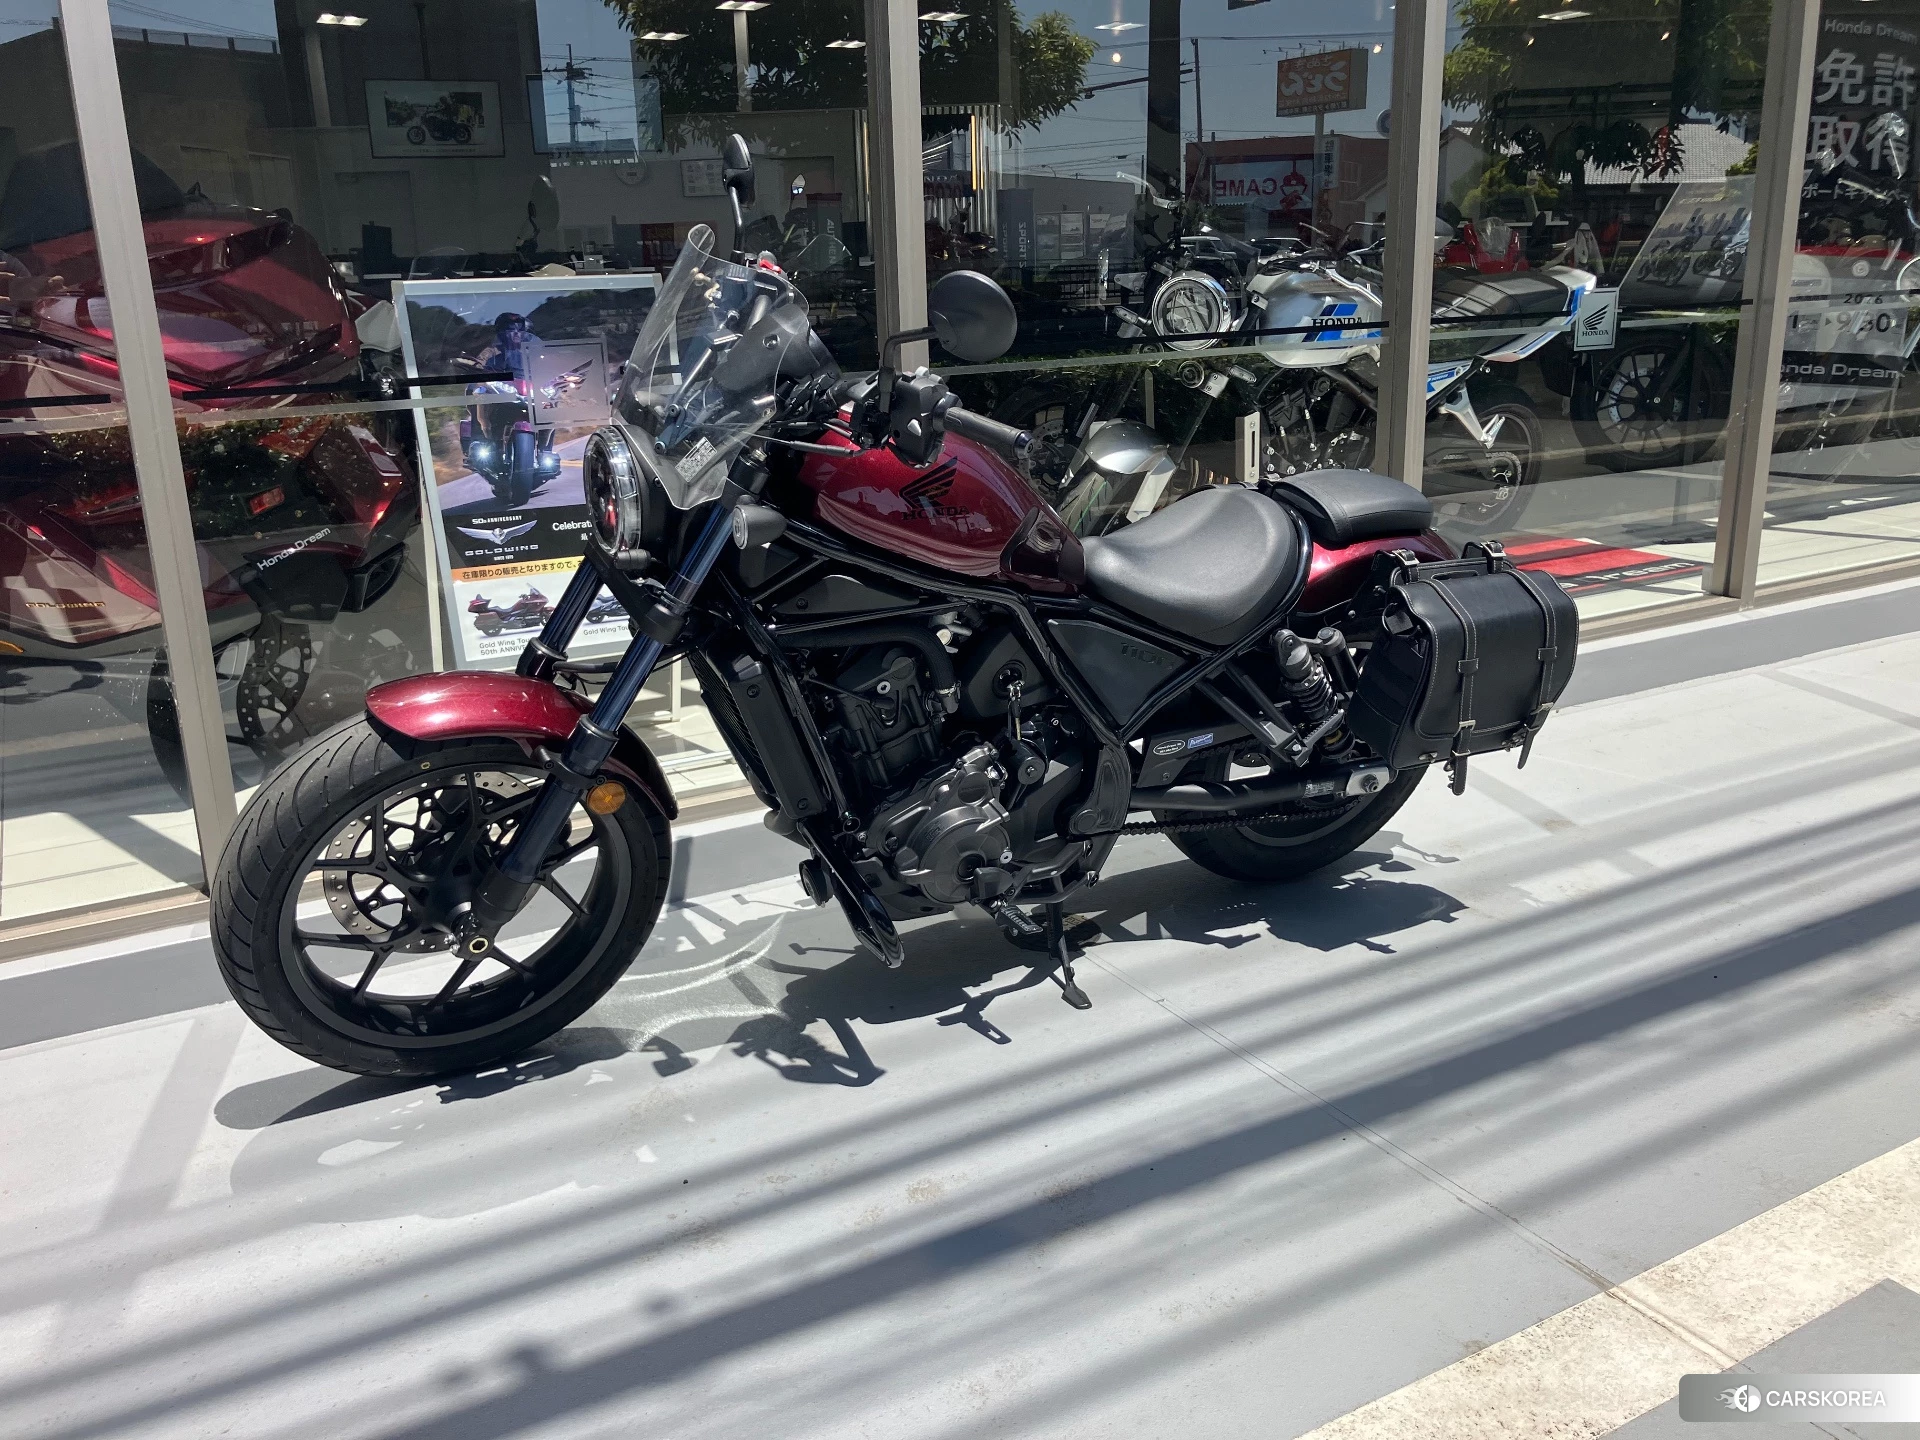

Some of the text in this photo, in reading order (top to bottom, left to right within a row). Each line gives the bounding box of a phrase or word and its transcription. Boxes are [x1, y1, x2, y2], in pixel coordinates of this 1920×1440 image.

[1824, 19, 1919, 45] Honda Dream
[1814, 48, 1916, 110] 免許
[1311, 317, 1362, 327] HONDA
[1582, 329, 1609, 337] HONDA
[1781, 363, 1901, 379] onda Dream
[256, 527, 332, 571] Honda Dream
[583, 628, 598, 636] Gold
[599, 627, 617, 635] Wing
[479, 641, 496, 649] Gold
[497, 639, 516, 648] Wing
[480, 648, 498, 656] 50th
